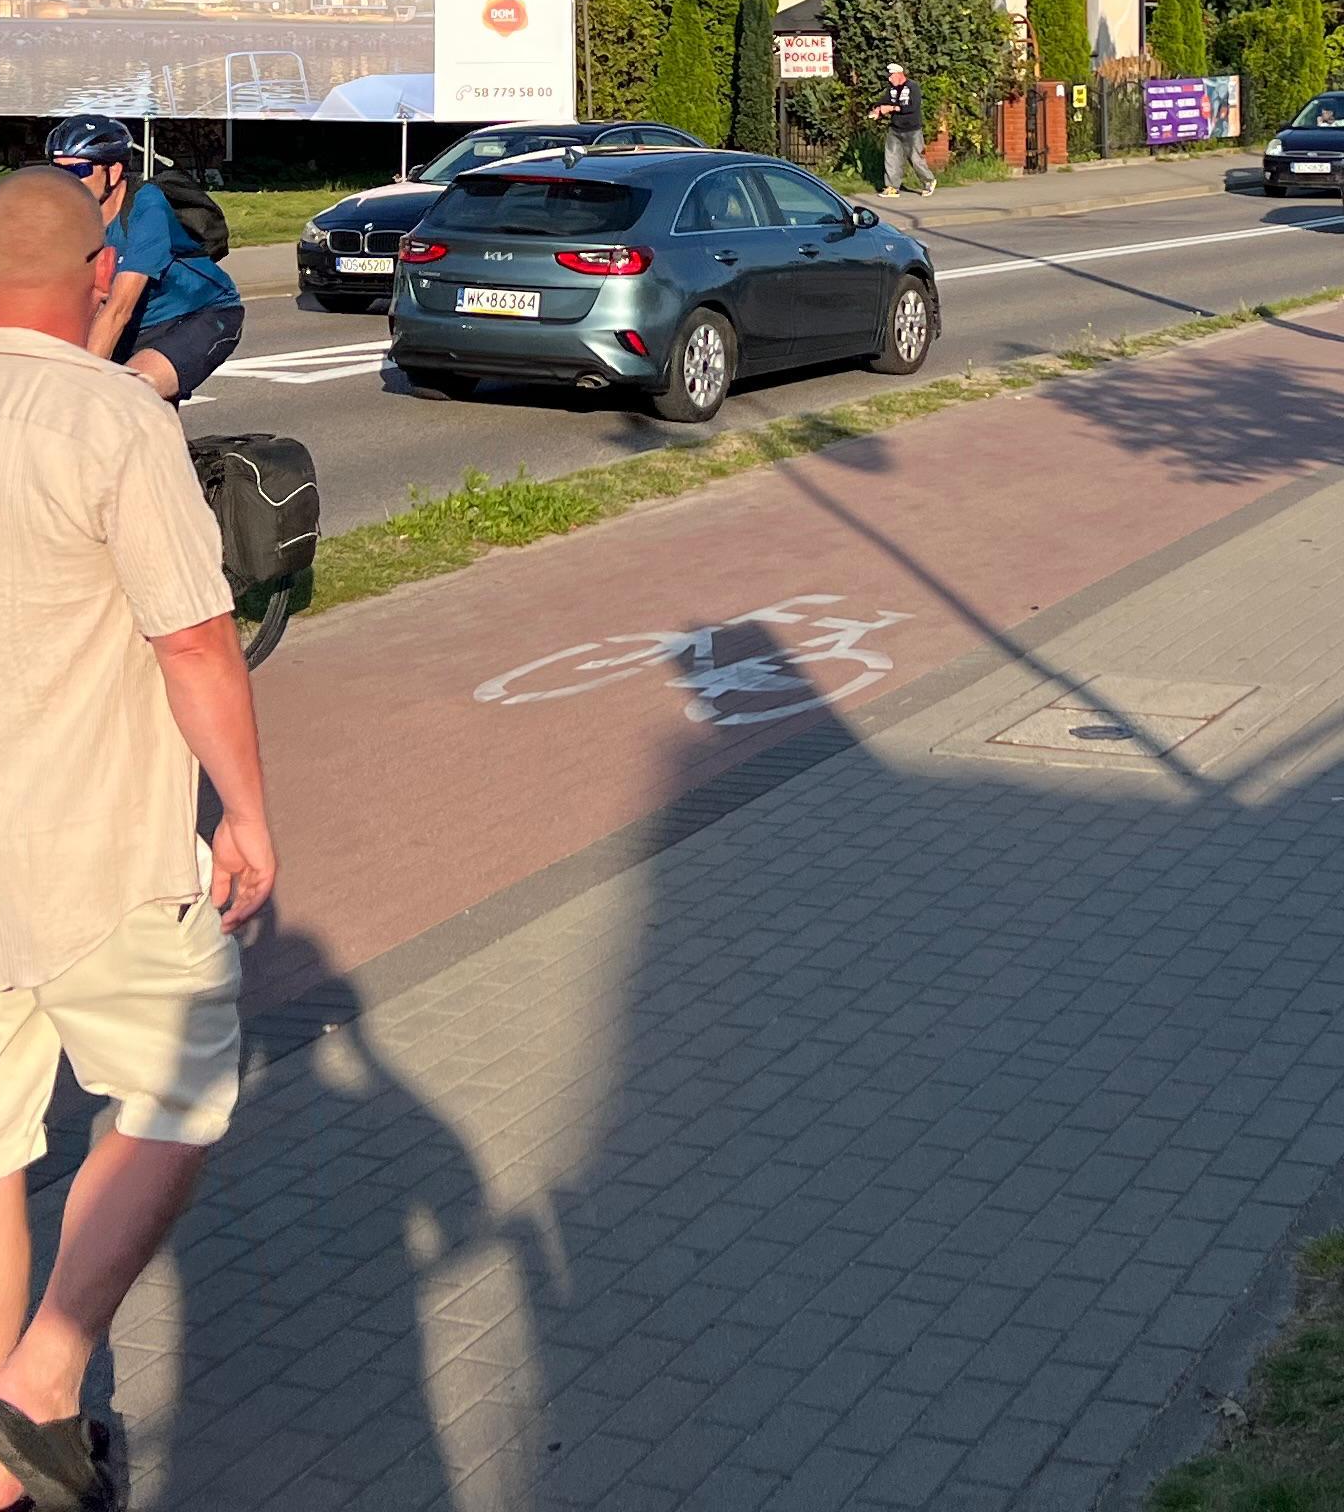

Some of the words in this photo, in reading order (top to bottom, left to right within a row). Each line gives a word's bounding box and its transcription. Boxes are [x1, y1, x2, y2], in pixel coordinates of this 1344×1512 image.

[784, 38, 827, 47] WOLNE
[784, 52, 829, 62] POKOJE
[474, 87, 489, 97] 58
[493, 87, 516, 97] 779
[519, 87, 534, 97] 58
[537, 87, 553, 97] 00
[490, 292, 536, 310] 86364
